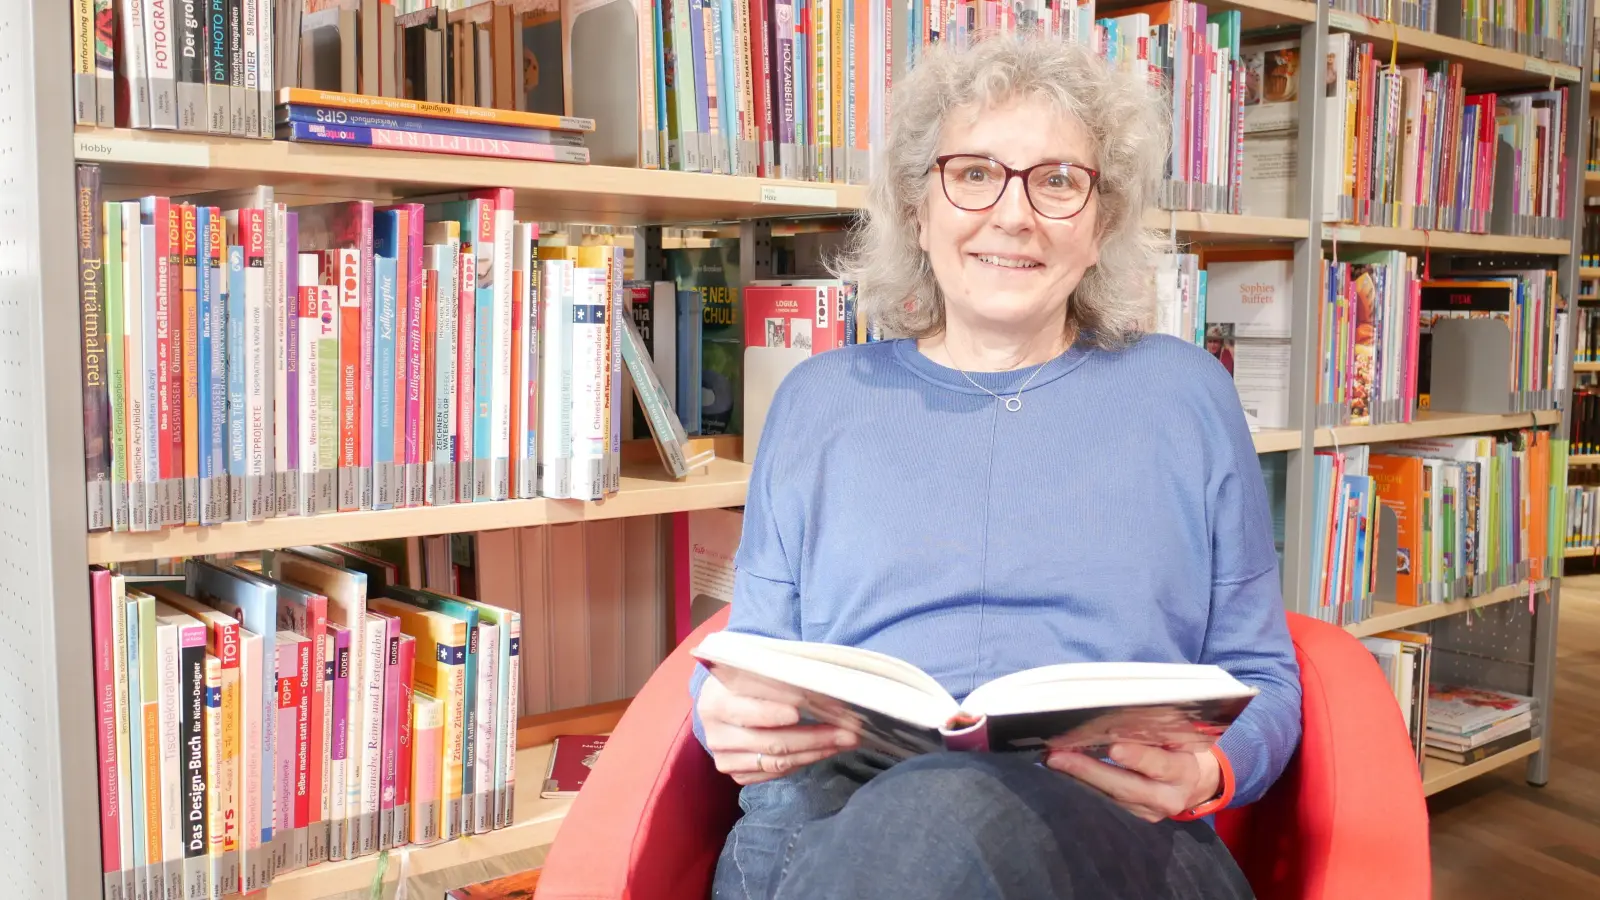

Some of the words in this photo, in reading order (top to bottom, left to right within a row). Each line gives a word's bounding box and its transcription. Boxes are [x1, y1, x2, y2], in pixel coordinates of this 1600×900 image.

[231, 6, 240, 51] fotografieren
[246, 27, 254, 36] 50
[713, 2, 721, 33] Weide
[183, 31, 196, 58] Der
[213, 13, 224, 57] PHOTO
[714, 37, 722, 56] Mit
[213, 60, 225, 81] DIY
[231, 52, 240, 86] Menschen
[783, 43, 793, 122] HOLZARBEITEN
[315, 108, 347, 125] GIPS
[350, 115, 398, 129] Werkstattbuch
[80, 142, 112, 156] Hobby
[378, 130, 510, 154] SKULPTUREN
[80, 186, 92, 248] Kreativkurs
[169, 209, 179, 249] TOPP
[184, 210, 196, 251] TOPP
[481, 203, 491, 239] TOPP
[203, 224, 211, 264] Pigmenten
[210, 214, 220, 253] TOPP
[251, 213, 261, 253] TOPP
[344, 253, 357, 303] TOPP
[465, 257, 474, 289] TOPP
[157, 256, 168, 339] Keilrahmen
[307, 287, 316, 316] TOPP
[613, 292, 622, 307] für
[775, 300, 798, 308] LOGIKA
[1239, 282, 1275, 297] Sophies
[1241, 294, 1273, 305] Buffets
[288, 296, 296, 317] Trend
[321, 290, 332, 335] TOPP
[411, 296, 421, 327] Design
[817, 289, 827, 324] TOPP
[82, 257, 105, 388] Porträtmalerei
[203, 312, 211, 338] Blanke
[288, 319, 296, 329] im
[159, 343, 168, 358] der
[171, 329, 182, 373] Ölmalerei
[287, 330, 297, 373] Keilrahmen
[308, 341, 316, 360] lernt
[411, 329, 421, 351] trifft
[594, 326, 602, 379] Tuschmalerei
[613, 309, 622, 373] Modellbahnen
[159, 360, 168, 383] Buch
[308, 362, 317, 387] laufen
[410, 353, 421, 402] Kalligrafie
[114, 369, 125, 435] Grundlagenbuch
[160, 384, 170, 411] große
[172, 381, 182, 442] BASISWISSEN
[211, 382, 221, 443] BASISWISSEN
[308, 388, 316, 407] Linie
[345, 364, 355, 430] SYMBOL-BIBLIOTHEK
[593, 382, 602, 430] Chinesische
[132, 399, 143, 446] Acrylbilder
[160, 412, 169, 431] Das
[308, 408, 316, 421] die
[309, 422, 317, 446] Wenn
[223, 624, 236, 664] TOPP
[390, 640, 398, 665] DUDEN
[470, 630, 478, 654] DUDEN
[300, 647, 309, 687] Geschenke
[340, 651, 348, 678] DUDEN
[369, 628, 384, 691] Festgedichte
[191, 662, 202, 719] Nicht-Designer
[282, 679, 292, 706] TOPP
[455, 669, 464, 696] Zitate
[102, 684, 113, 713] falten
[163, 646, 177, 763] Tischdekorationen
[299, 696, 308, 722] kaufen
[369, 693, 380, 714] und
[454, 697, 464, 729] Zitate,
[103, 716, 116, 763] kunstvoll
[192, 720, 201, 732] für
[299, 722, 308, 741] statt
[367, 716, 379, 750] Reime
[466, 711, 476, 741] Anlässe
[299, 741, 308, 771] machen
[453, 730, 463, 761] Zitate,
[466, 742, 475, 767] Runde
[187, 735, 205, 822] Design-Buch
[385, 748, 394, 781] Sprüche
[107, 766, 117, 817] Servietten
[281, 759, 290, 812] Geldgeschenke
[297, 772, 307, 796] Selber
[189, 824, 203, 851] Das
